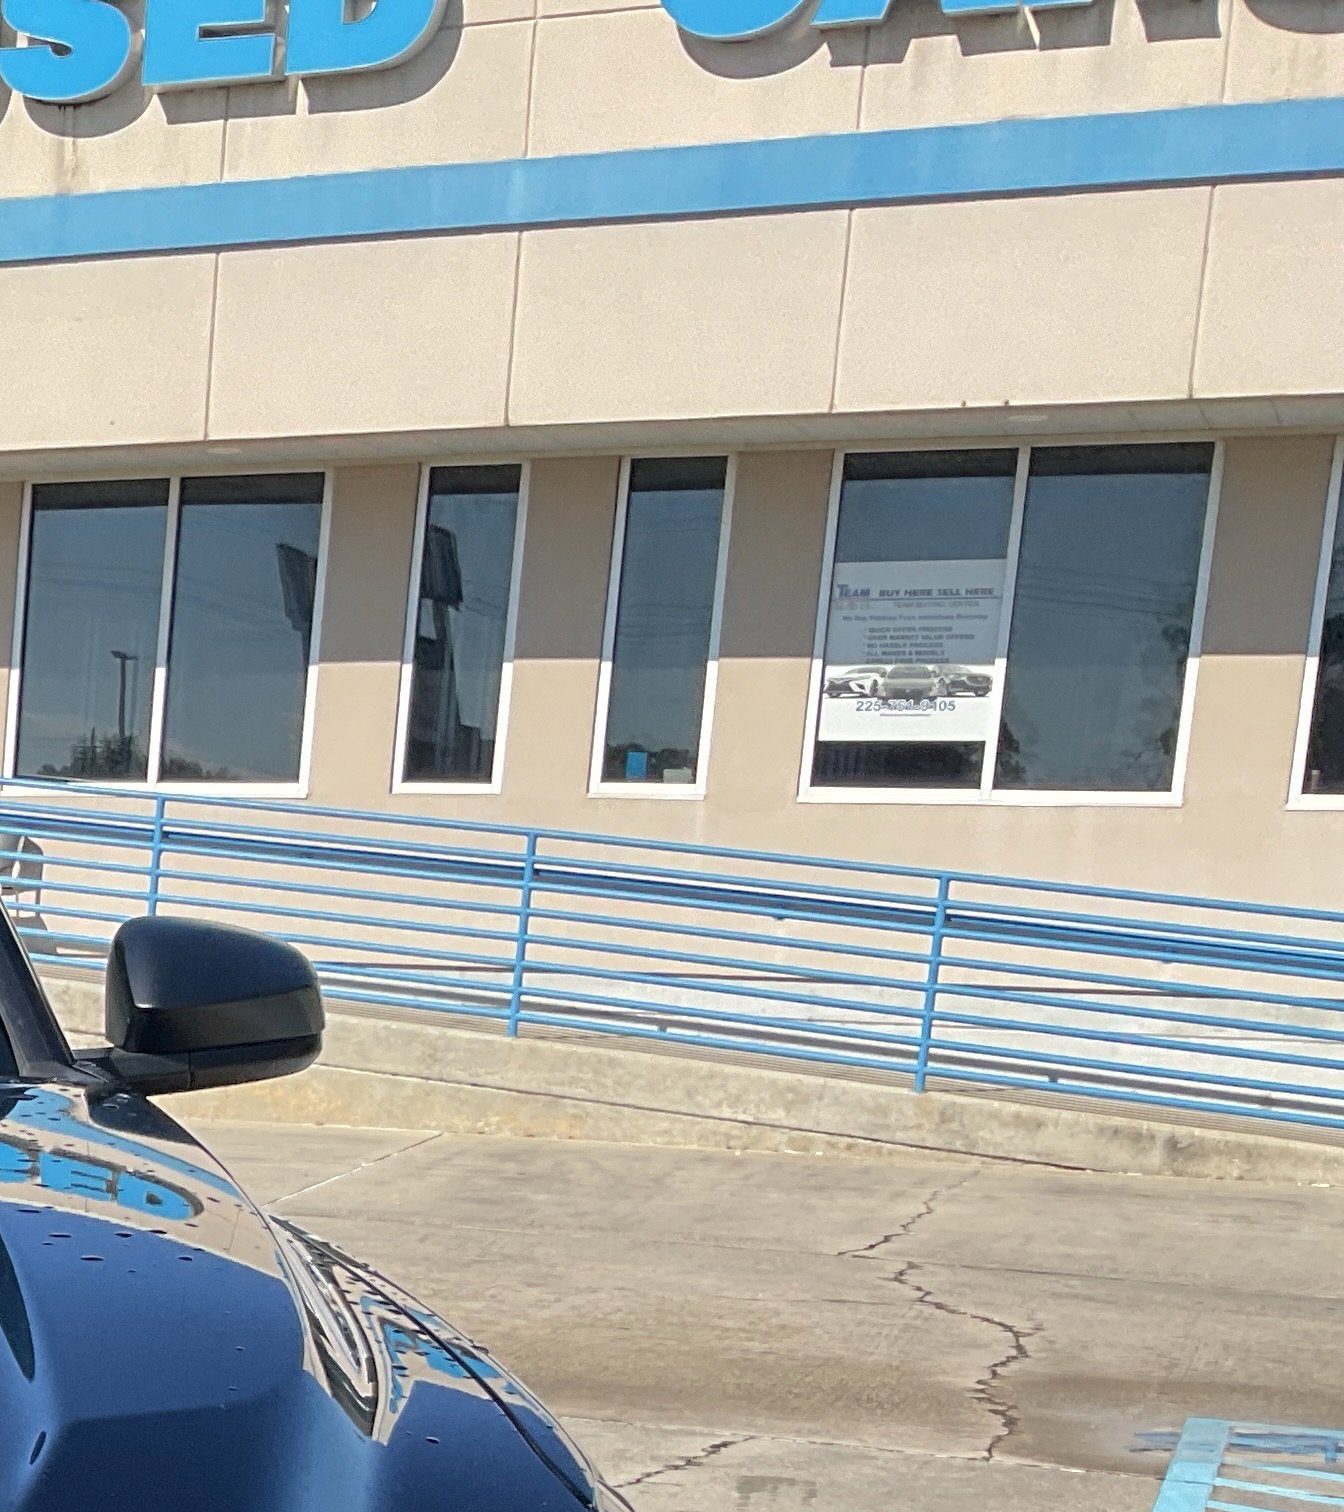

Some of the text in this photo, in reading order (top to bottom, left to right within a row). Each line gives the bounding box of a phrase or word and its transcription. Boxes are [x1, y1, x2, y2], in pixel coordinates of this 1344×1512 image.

[878, 588, 900, 597] BUY
[904, 588, 933, 597] HERE
[937, 587, 961, 596] SELL
